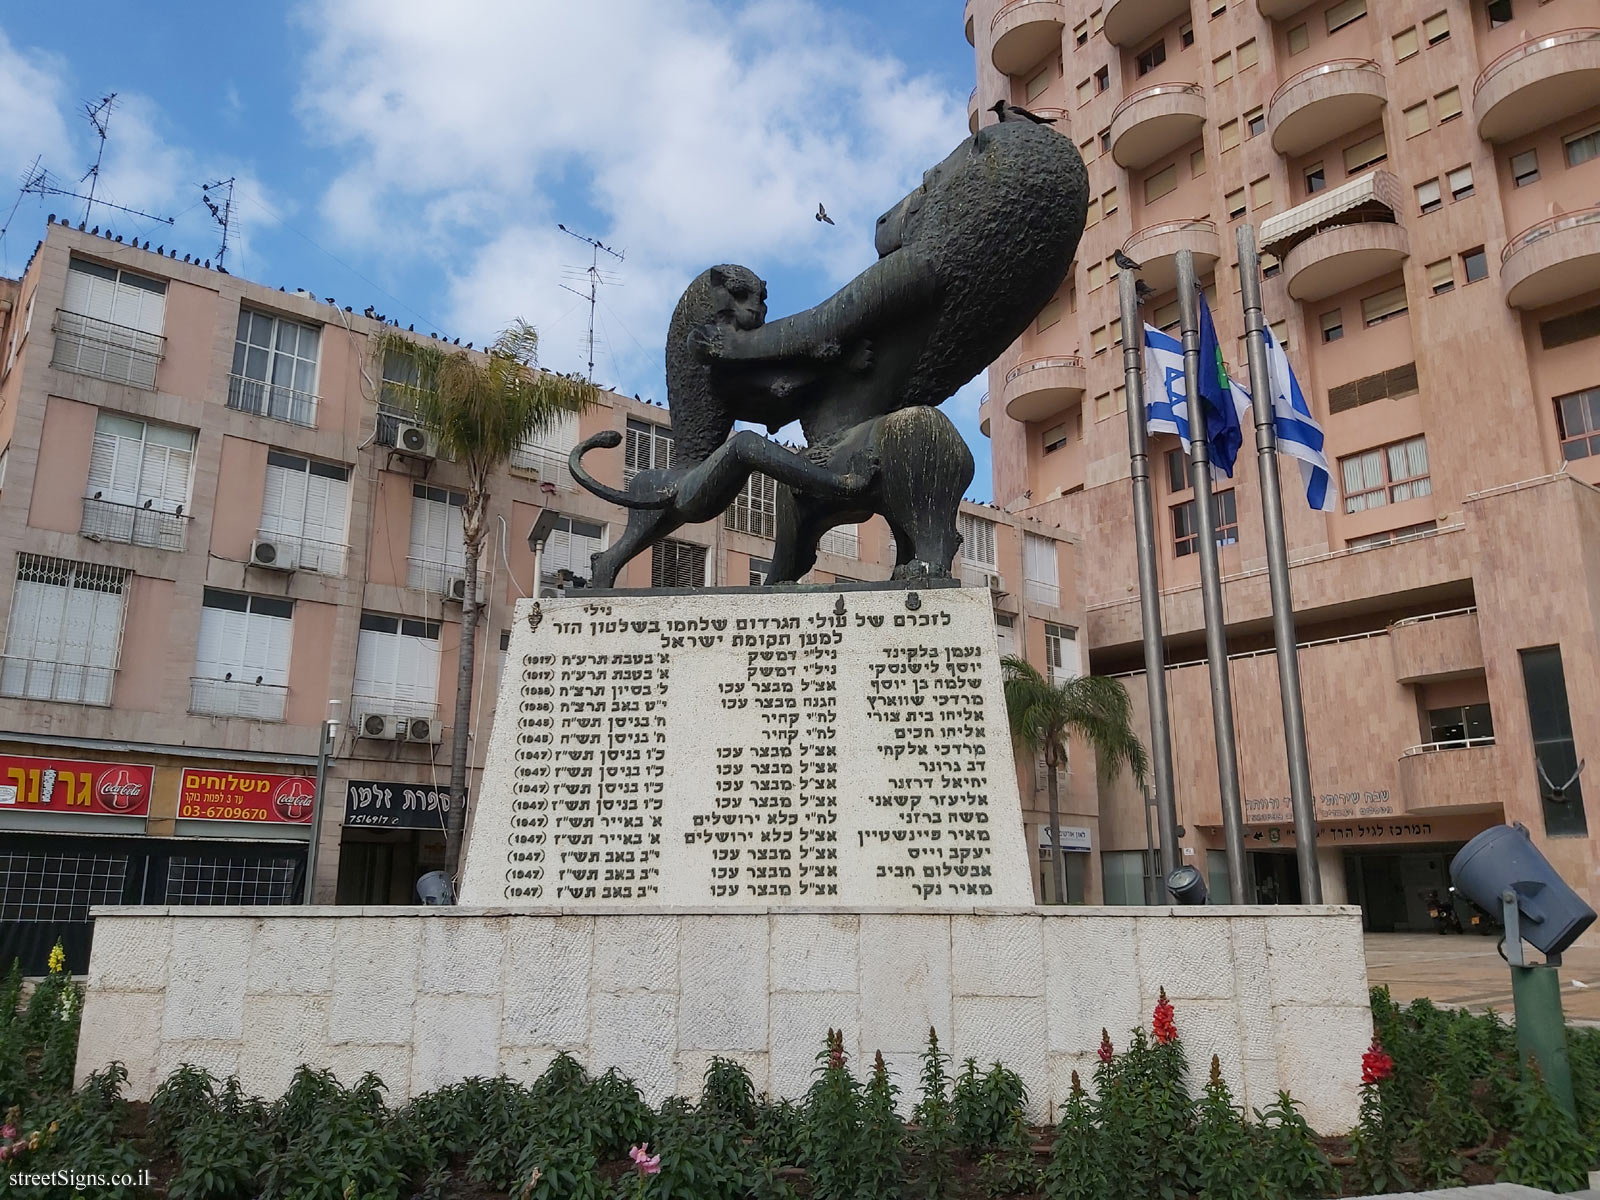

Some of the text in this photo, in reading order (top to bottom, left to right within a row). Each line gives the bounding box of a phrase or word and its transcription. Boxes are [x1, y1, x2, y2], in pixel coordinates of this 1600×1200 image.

[583, 604, 612, 616] נילי
[553, 610, 951, 636] לזכרם של עולי הגרדום שלחמו בשלטון הזר
[660, 629, 842, 649] למען תקומת ישראל
[522, 653, 556, 667] (1917)
[611, 654, 654, 665] בטבת
[747, 650, 797, 666] דמשק
[882, 644, 939, 663] בלקינד
[944, 646, 981, 662] נעמן
[522, 669, 555, 682] (1917)
[611, 670, 653, 681] בטבת
[747, 666, 796, 682] דמשק
[869, 660, 939, 679] לישנסקי
[946, 662, 982, 677] יוסף
[718, 683, 745, 694] עכו
[751, 682, 793, 693] מבצר
[870, 679, 906, 694] יוסף
[912, 679, 929, 695] בן
[934, 675, 982, 689] שלמה
[520, 685, 555, 697] (1938)
[611, 685, 652, 701] בסיון
[519, 700, 554, 714] (1938)
[611, 701, 639, 712] באב
[721, 698, 748, 710] עכו
[755, 698, 797, 708] מבצר
[803, 697, 836, 708] הגנה
[866, 695, 925, 710] שווארץ
[932, 695, 984, 706] מרדכי
[761, 713, 800, 729] קהיר
[867, 712, 900, 722] צורי
[905, 711, 934, 722] בית
[940, 707, 984, 722] אליהו
[517, 717, 554, 729] (1945)
[608, 717, 650, 733] בניסן
[762, 729, 799, 745] קהיר
[894, 728, 934, 739] חכים
[940, 724, 986, 738] אליהו
[517, 732, 554, 746] (1945)
[608, 733, 649, 749] בניסן
[514, 748, 552, 761] (1947)
[600, 749, 641, 766] בניסן
[716, 747, 743, 758] עכו
[750, 746, 792, 758] מבצר
[877, 741, 928, 761] אלקחי
[934, 743, 986, 758] מרדכי
[514, 765, 551, 779] (1947)
[716, 764, 743, 775] עכו
[751, 763, 793, 774] מבצר
[919, 761, 961, 772] גרונר
[967, 761, 986, 771] דב
[599, 766, 640, 782] בניסן
[941, 774, 987, 788] יחיאל
[186, 774, 271, 793] משלוחים
[513, 781, 550, 795] (1947)
[716, 780, 744, 792] עכו
[750, 780, 792, 791] מבצר
[888, 778, 933, 789] דרזנר
[350, 784, 466, 812] ספרת זלמן
[598, 783, 639, 799] בניסן
[185, 792, 244, 805] עד 3 לפנות בוקר
[512, 798, 548, 813] (1947)
[715, 797, 742, 809] עכו
[749, 797, 792, 808] מבצר
[868, 795, 922, 812] קשאני
[929, 791, 988, 806] אליעזר
[183, 805, 268, 820] 03-6709670
[596, 799, 638, 816] בניסן
[510, 814, 548, 828] (1947)
[600, 816, 644, 828] באייר
[692, 811, 760, 826] ירושלים
[767, 810, 798, 826] כלא
[899, 812, 942, 824] ברזני
[948, 812, 989, 823] משה
[684, 829, 753, 844] ירושלים
[761, 827, 793, 843] כלא
[948, 829, 990, 841] מאיר
[1330, 828, 1353, 841] הרך
[1358, 824, 1384, 838] לגיל
[1389, 823, 1432, 837] המרכז
[508, 831, 547, 846] (1947)
[599, 834, 642, 845] באייר
[857, 830, 941, 847] פיינשטיין
[507, 849, 545, 864] (1947)
[605, 851, 635, 863] באב
[712, 849, 740, 861] עכו
[747, 849, 791, 860] מבצר
[907, 848, 943, 859] וייס
[949, 848, 991, 864] יעקב
[505, 866, 544, 883] (1947)
[604, 869, 635, 881] באב
[711, 867, 739, 879] עכו
[746, 867, 791, 879] מבצר
[876, 865, 915, 878] חביב
[923, 861, 992, 878] אבשלום
[504, 884, 543, 900] (1947)
[602, 886, 632, 898] באב
[710, 885, 739, 897] עכו
[747, 884, 791, 897] מבצר
[912, 884, 942, 900] נקר
[949, 883, 993, 895] מאיר
